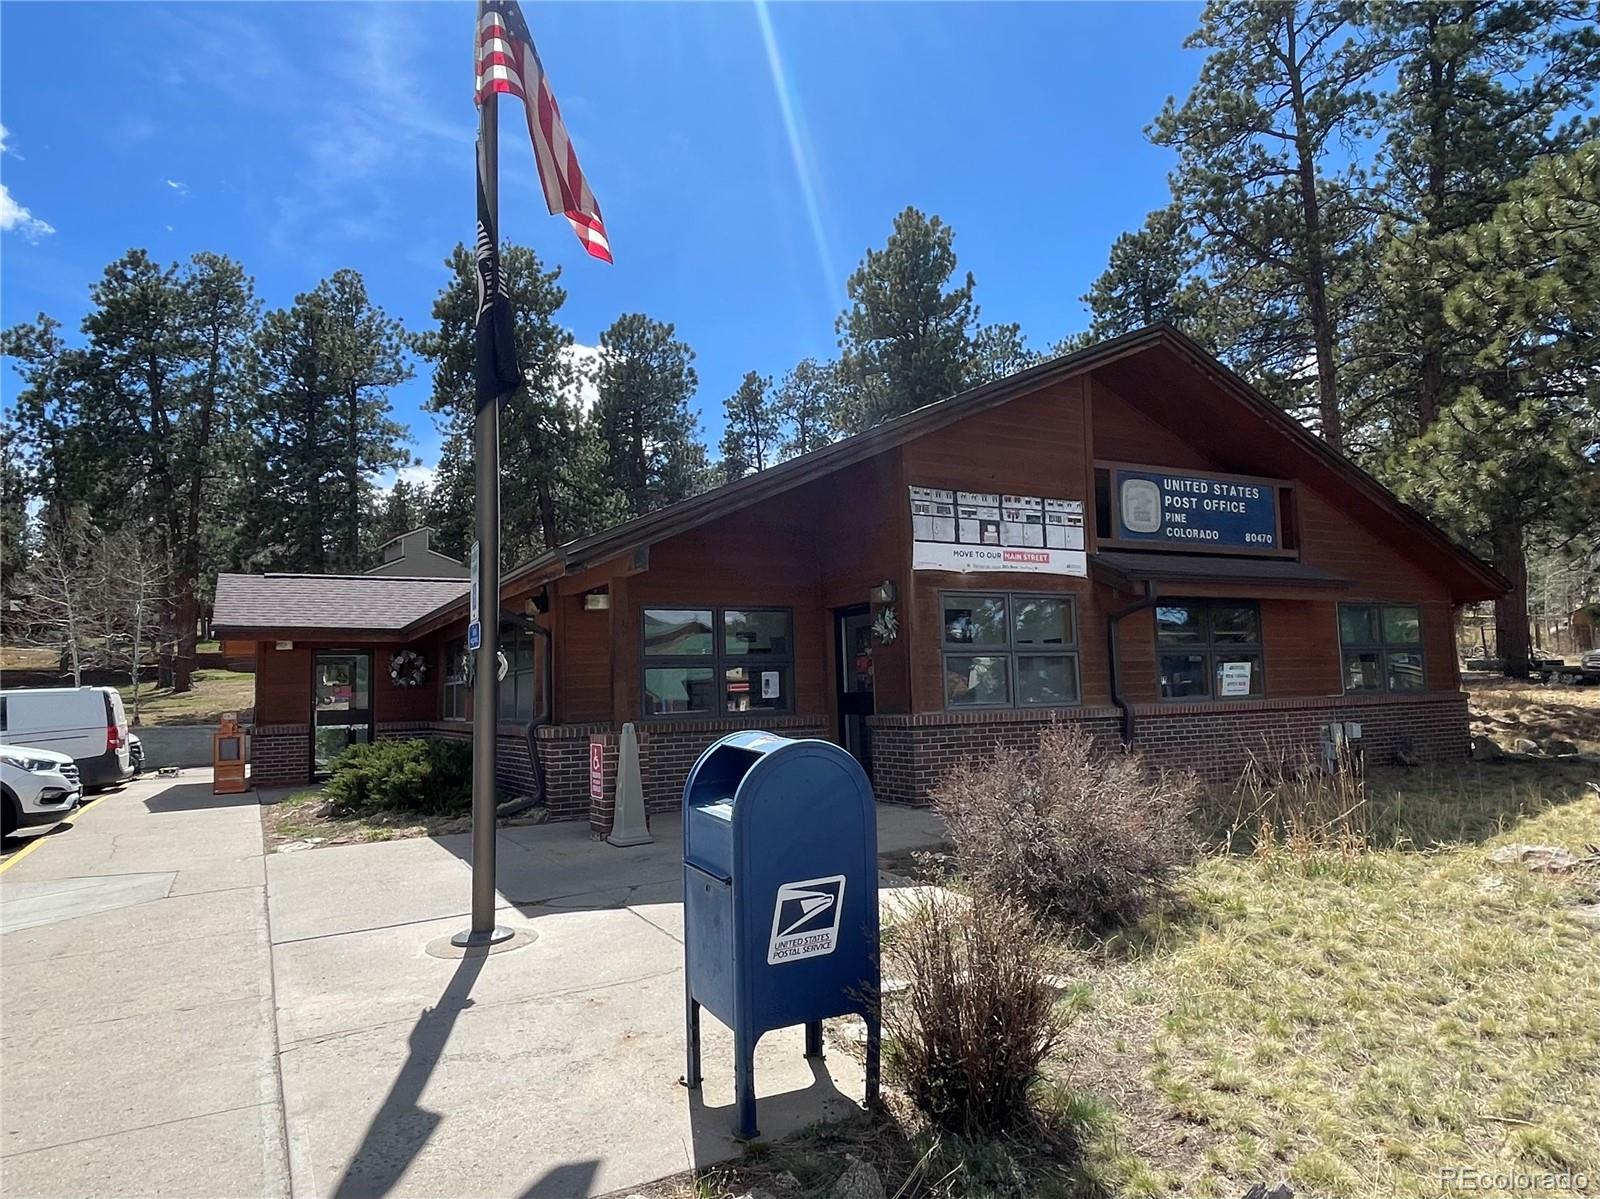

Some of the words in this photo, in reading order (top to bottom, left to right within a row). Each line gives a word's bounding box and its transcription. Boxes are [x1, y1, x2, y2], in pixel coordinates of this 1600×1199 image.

[1163, 478, 1208, 493] UNITED
[1213, 484, 1259, 499] STATES
[1164, 495, 1197, 509] POST
[1203, 499, 1246, 513] OFFICE
[1165, 512, 1187, 523] PINE
[1166, 527, 1219, 540] COLORADO
[1245, 533, 1272, 544] 80470
[953, 550, 973, 558] MOVE
[976, 551, 985, 559] TO
[986, 552, 1002, 560] OUR
[1004, 552, 1022, 561] MAIN
[1023, 553, 1048, 562] STREET
[774, 938, 802, 950] UNITED
[804, 933, 830, 944] STATES
[773, 948, 801, 959] POSTAL
[802, 942, 832, 953] SERVICE
